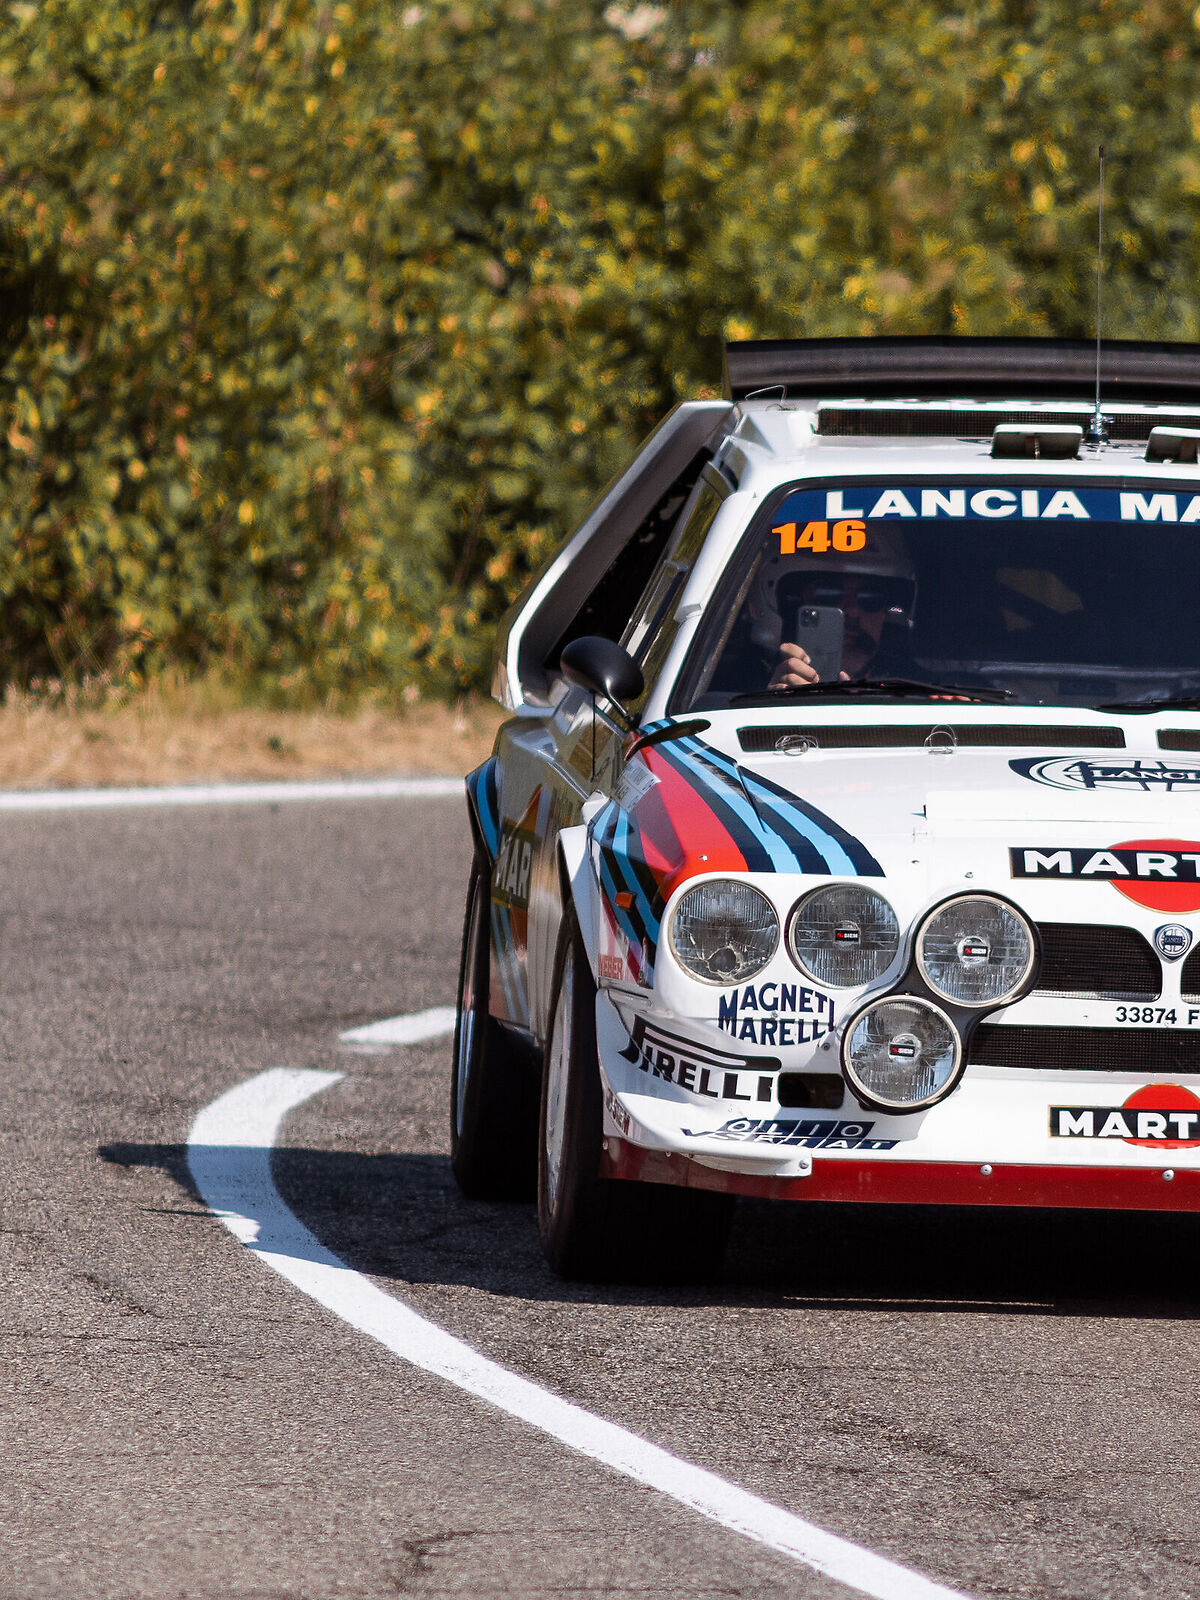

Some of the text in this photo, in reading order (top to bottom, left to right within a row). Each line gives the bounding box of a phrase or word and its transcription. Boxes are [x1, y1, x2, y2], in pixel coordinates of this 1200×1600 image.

[825, 489, 1091, 520] LANCIA
[771, 519, 866, 554] 146
[717, 981, 836, 1020] MAGNETI
[1115, 1006, 1177, 1024] 33874
[1187, 1009, 1200, 1025] F
[717, 1016, 836, 1047] MARELLI
[617, 1013, 782, 1102] PIRELLI
[727, 1118, 864, 1137] OLIO
